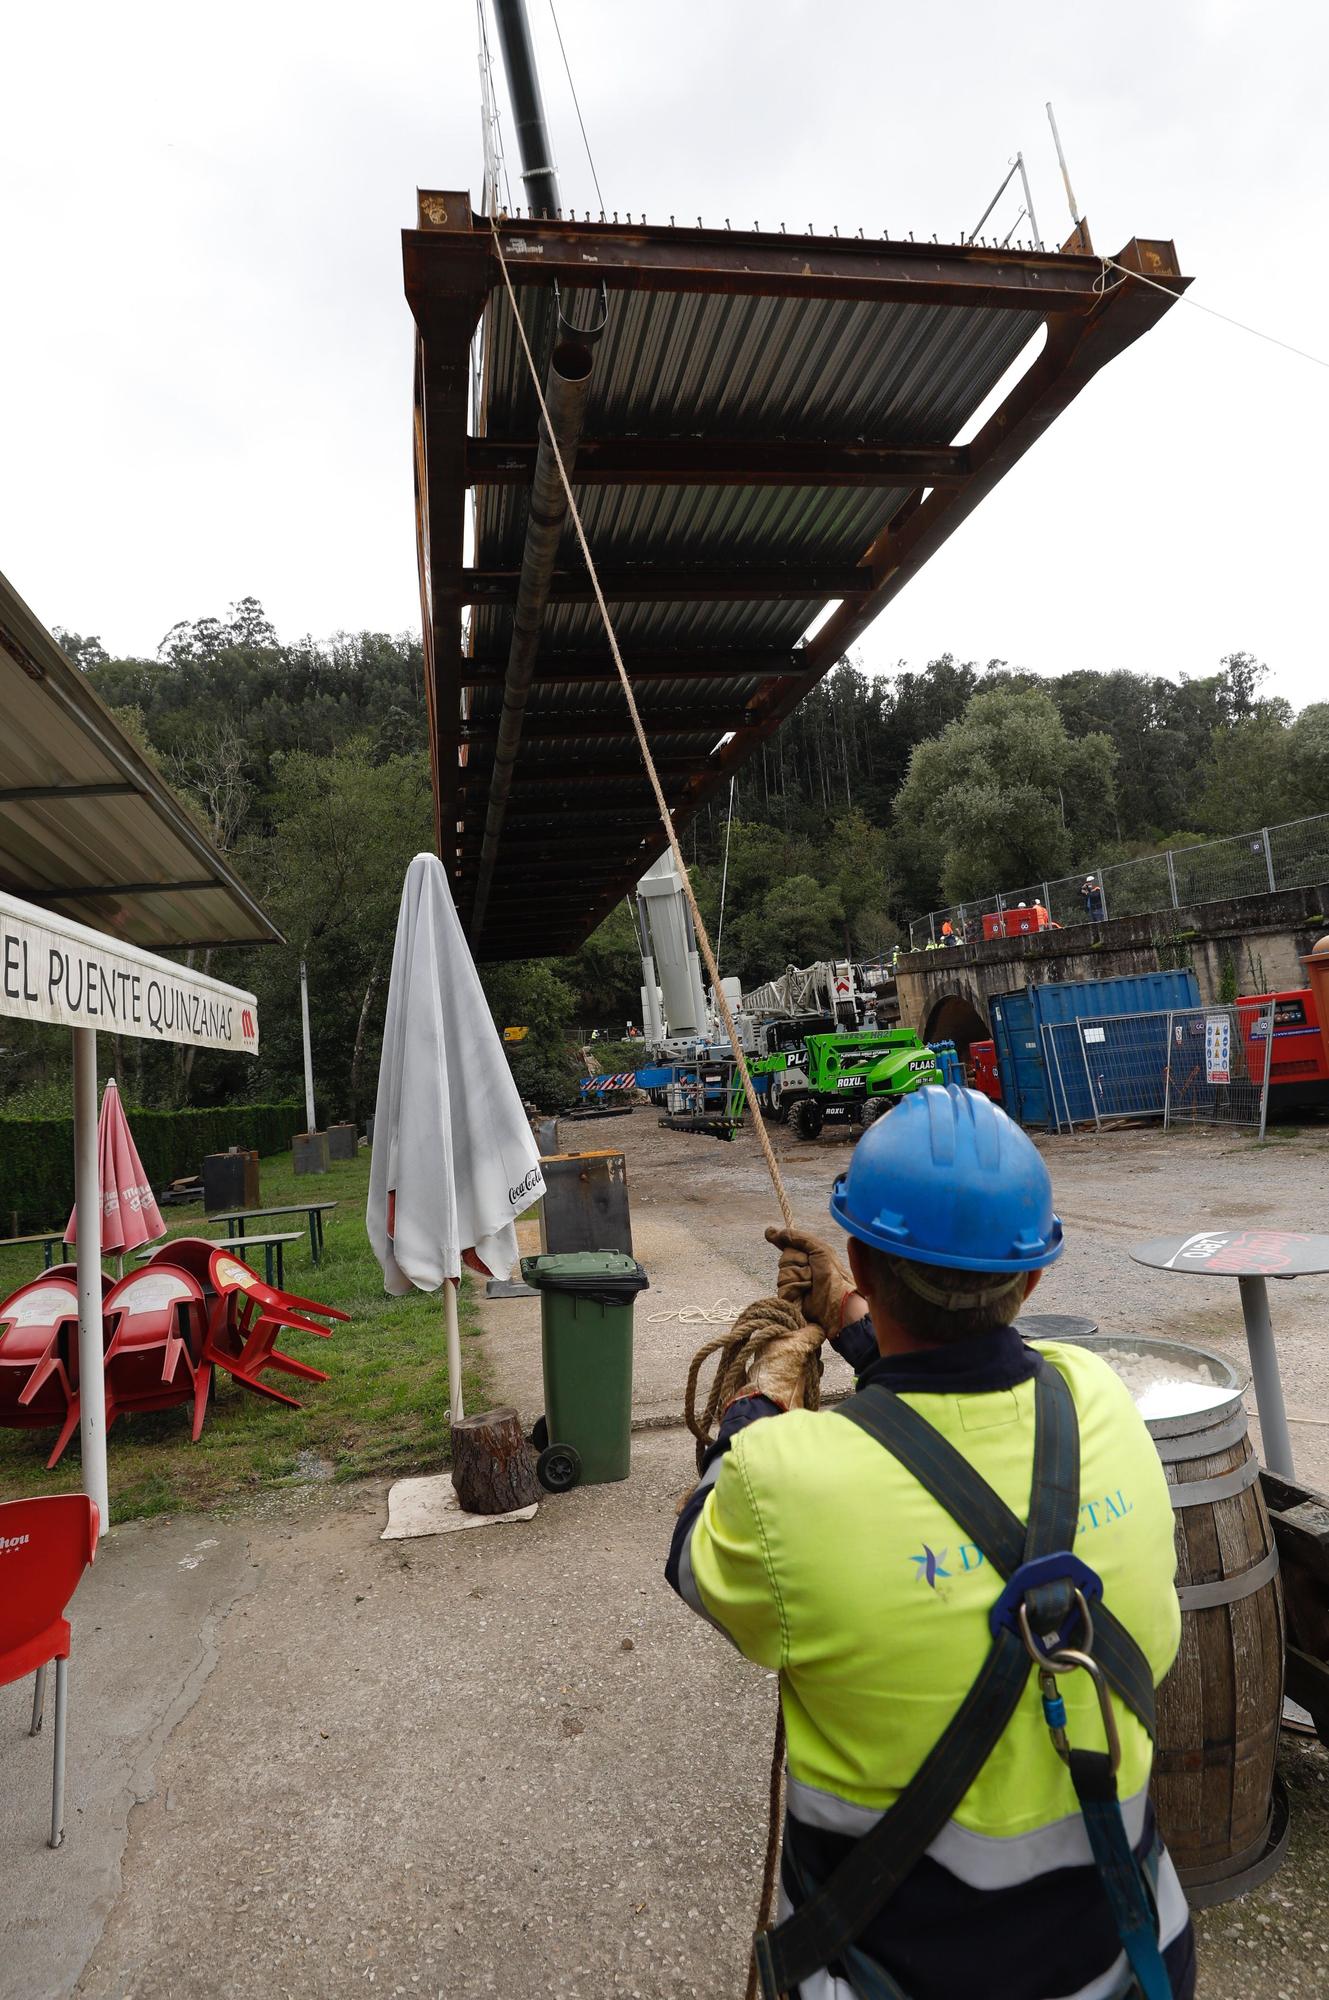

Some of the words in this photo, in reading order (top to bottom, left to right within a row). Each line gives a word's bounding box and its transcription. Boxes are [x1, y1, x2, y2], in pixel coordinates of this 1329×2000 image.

[4, 935, 38, 1002] EL
[48, 948, 141, 1023] PUENTE
[147, 981, 232, 1041] QUINZANAS
[787, 1053, 809, 1066] PLA
[909, 1060, 935, 1071] PLAAS
[837, 1077, 861, 1087] ROXU
